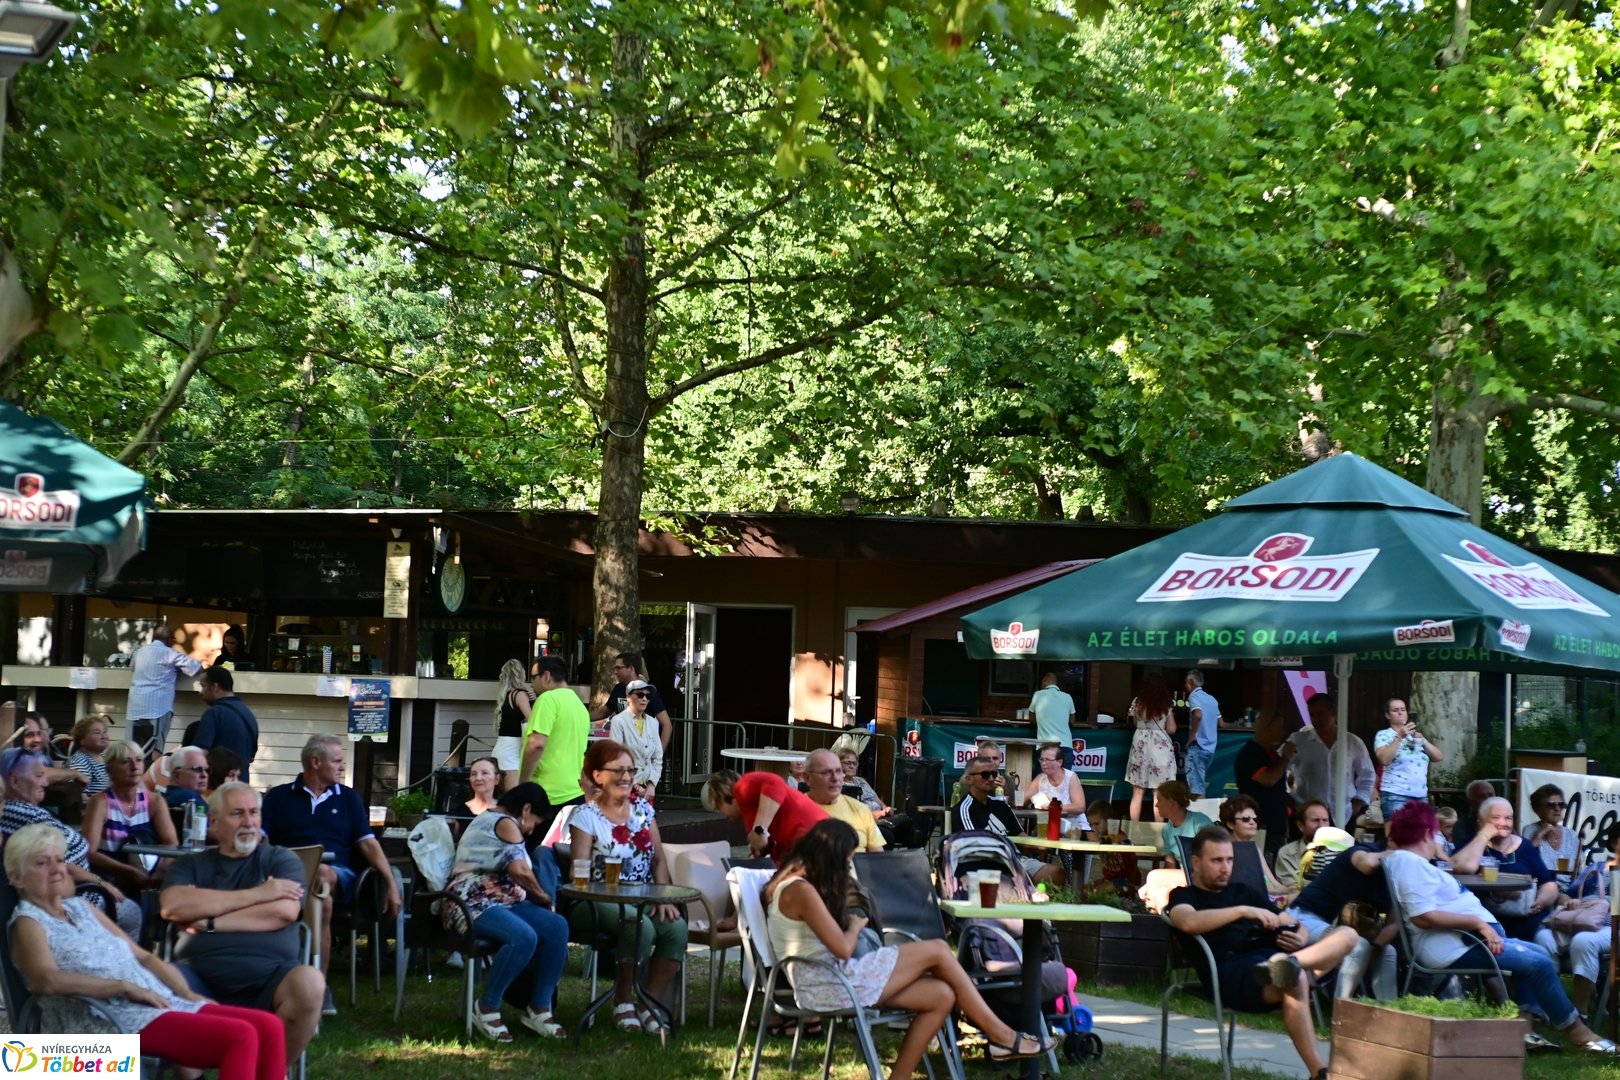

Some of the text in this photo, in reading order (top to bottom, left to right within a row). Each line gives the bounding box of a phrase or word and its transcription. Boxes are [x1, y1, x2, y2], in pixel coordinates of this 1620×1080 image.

[0, 499, 71, 522] ORSODI
[1158, 565, 1354, 592] BORSODI
[993, 637, 1036, 649] BORSODI
[1087, 627, 1338, 647] AZ ÉLET HABOS OLDALA
[1397, 626, 1451, 641] BORSODI
[1594, 640, 1620, 659] HABO
